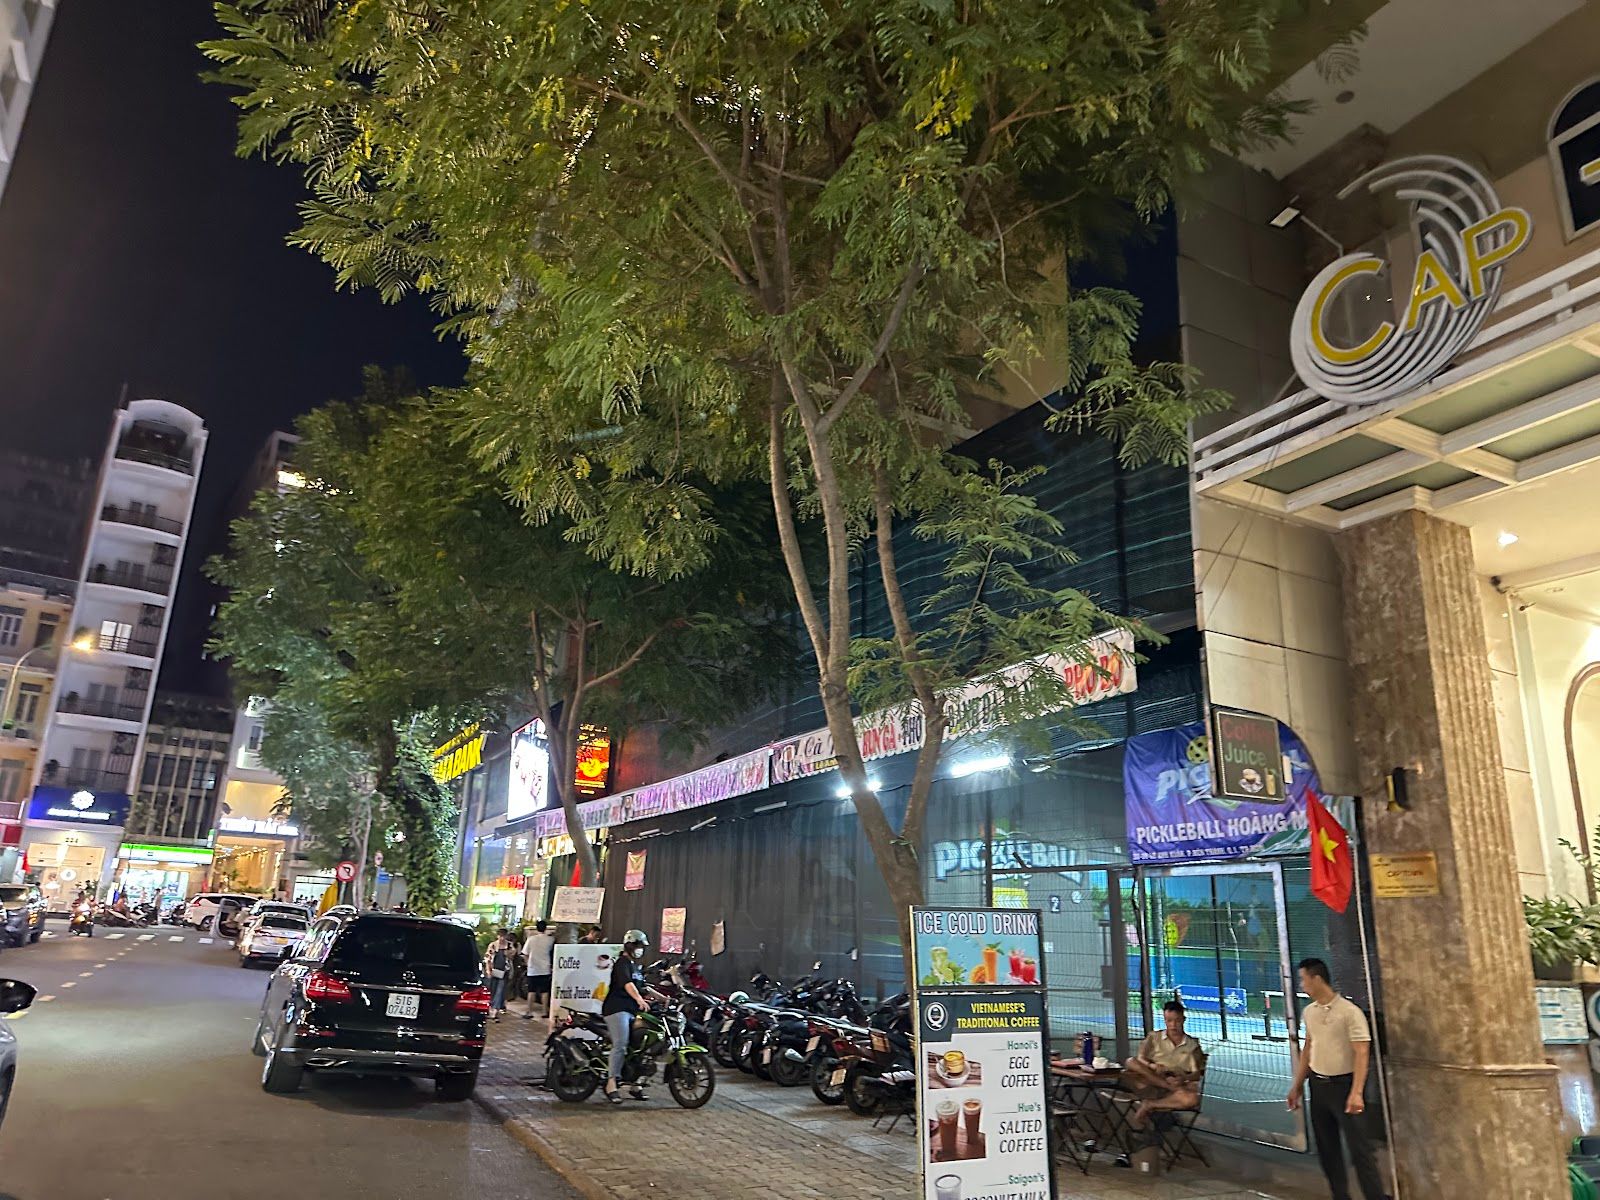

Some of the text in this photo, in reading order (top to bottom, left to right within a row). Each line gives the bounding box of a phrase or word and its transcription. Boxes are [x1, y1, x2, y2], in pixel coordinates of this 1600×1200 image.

[1308, 206, 1534, 366] CAP
[452, 733, 485, 779] BANK
[1224, 742, 1267, 766] Juice
[1136, 820, 1225, 845] PICKLEBALL
[1227, 810, 1288, 837] HOÀNG
[1051, 896, 1060, 912] 2
[918, 911, 1039, 936] ICE COLD DRINK
[558, 957, 581, 969] Coffee
[555, 986, 591, 999] Fruit Juice
[970, 1002, 1026, 1014] VIETNAMESE'S
[956, 1016, 1040, 1029] TRADITIONAL COFFEE
[1007, 1040, 1039, 1051] Hanoi's
[1009, 1056, 1030, 1070] EGG
[1001, 1074, 1040, 1088] COFFEE
[1017, 1102, 1042, 1113] Hue's
[998, 1119, 1043, 1135] SALTED
[999, 1137, 1044, 1154] COFFEE
[1007, 1173, 1046, 1187] Saigon's
